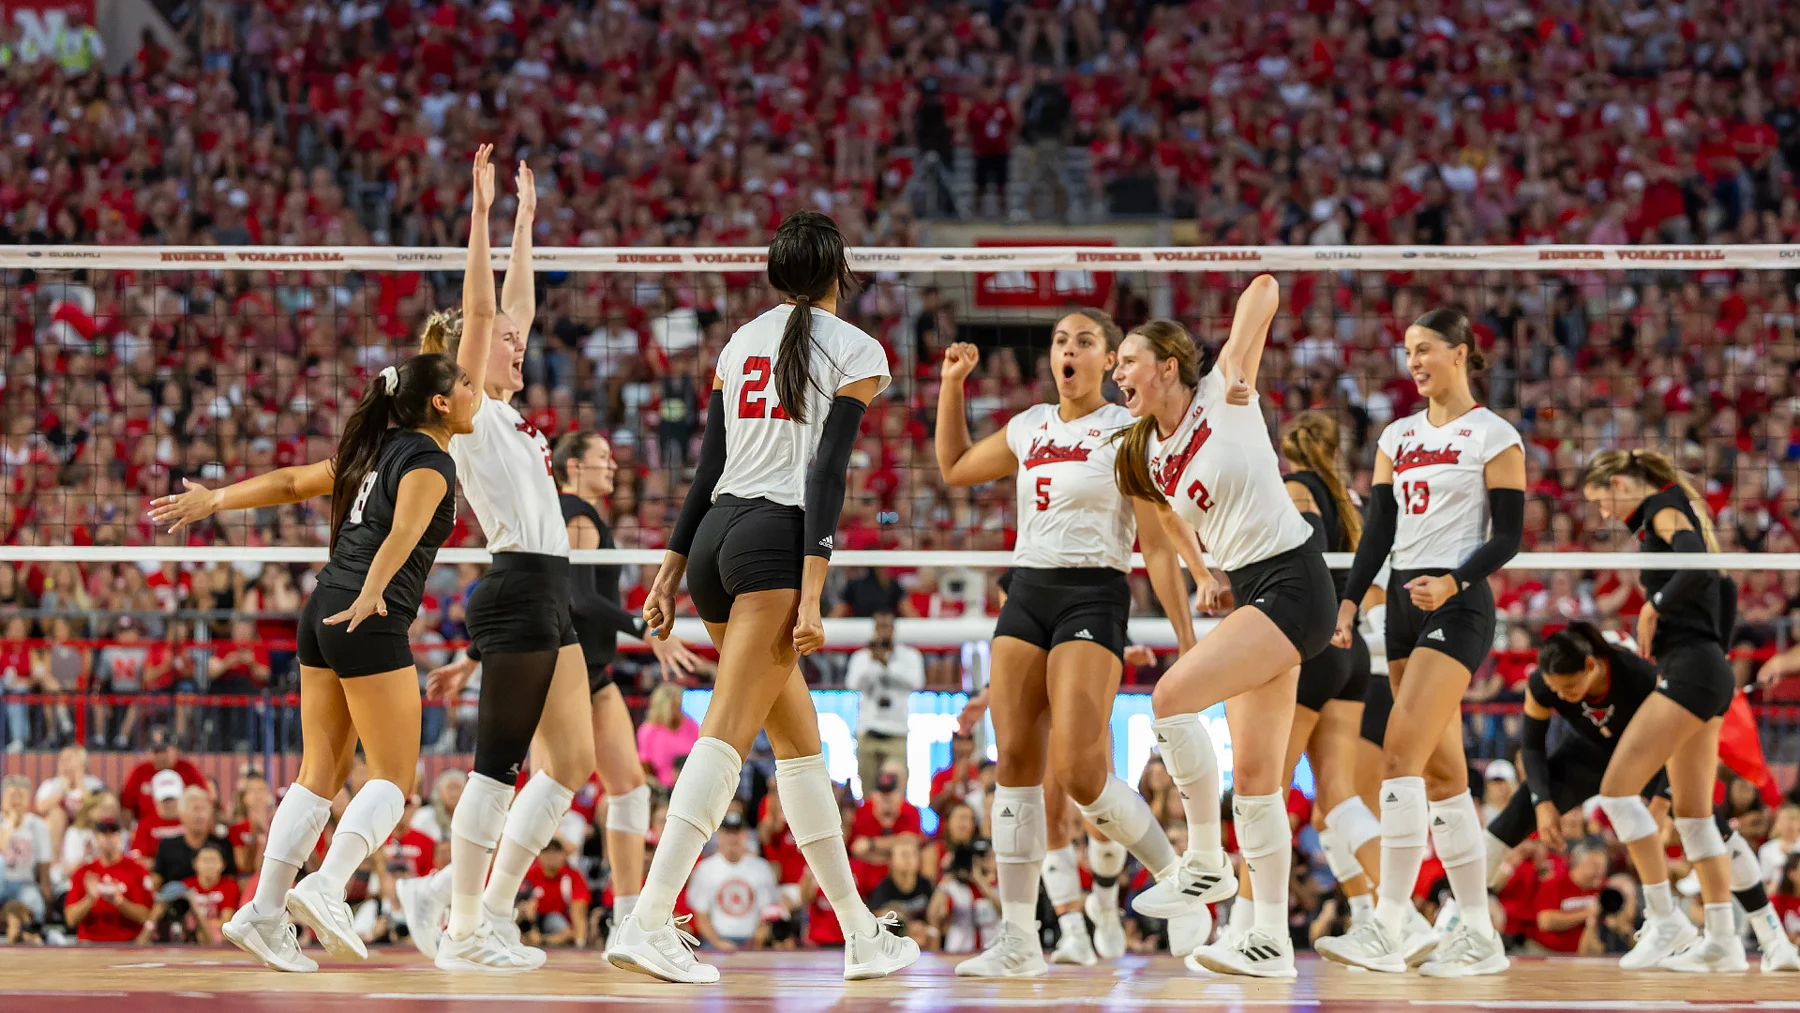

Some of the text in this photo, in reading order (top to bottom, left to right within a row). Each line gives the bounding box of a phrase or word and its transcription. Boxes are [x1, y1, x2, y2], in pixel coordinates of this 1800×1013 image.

[160, 252, 344, 262] HUSKER VOLLEYBALL
[616, 254, 769, 263] HUSKER VOLLEYB
[1076, 251, 1261, 262] HUSKER VOLLEYBALL
[1315, 252, 1362, 260] DUTEAU
[1538, 250, 1725, 261] HUSKER VOLLEYBALL
[738, 356, 791, 421] 2
[1035, 477, 1052, 511] 5
[1187, 479, 1215, 513] 2
[1402, 481, 1430, 514] 13
